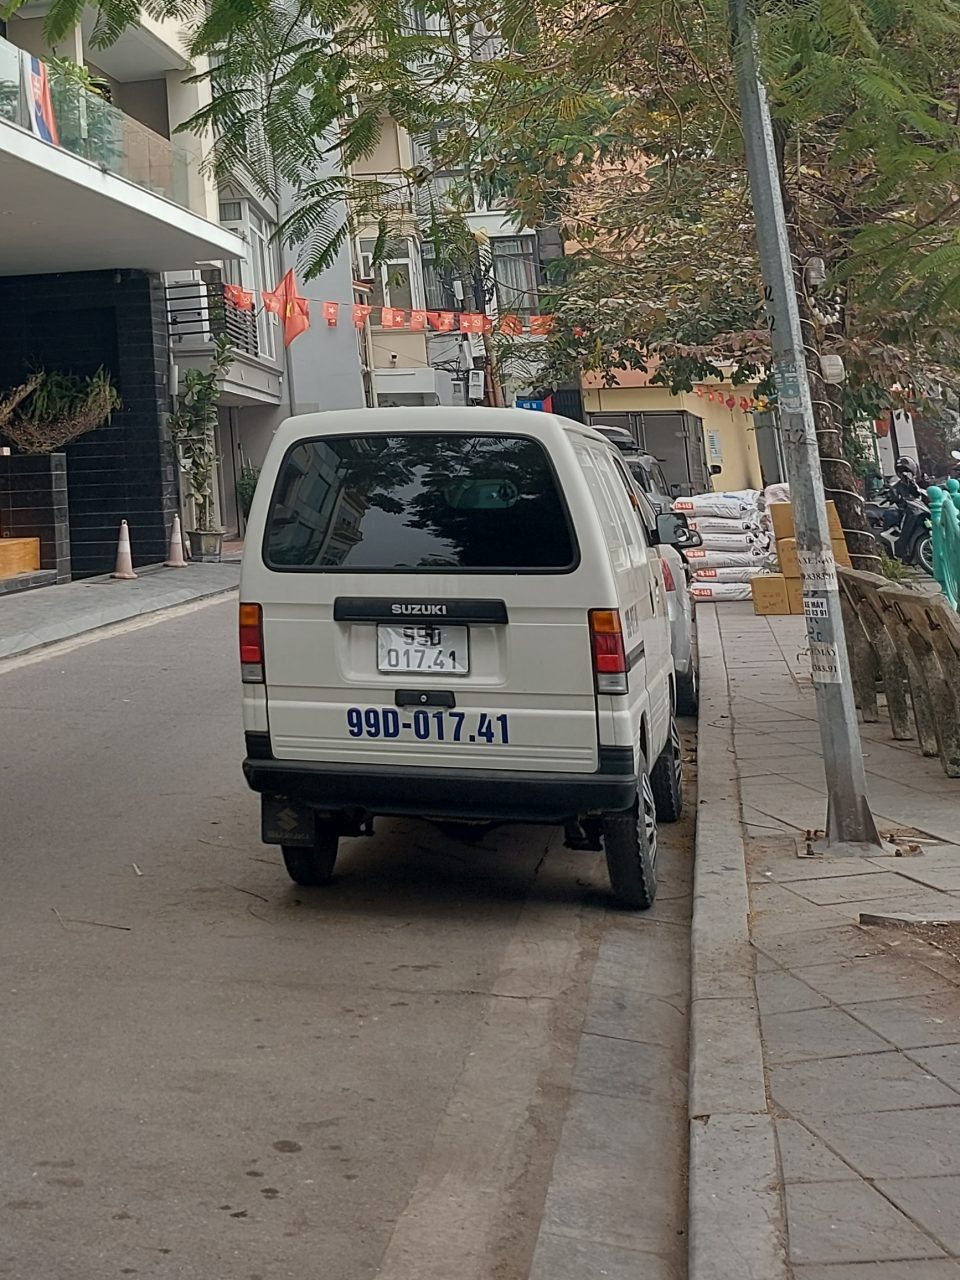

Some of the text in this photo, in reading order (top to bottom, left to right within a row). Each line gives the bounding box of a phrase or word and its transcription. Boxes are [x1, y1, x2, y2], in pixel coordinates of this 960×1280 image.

[391, 604, 447, 615] SUZUKI
[820, 609, 827, 617] 91
[387, 648, 456, 670] 017.41
[346, 707, 509, 744] 99D-017.41
